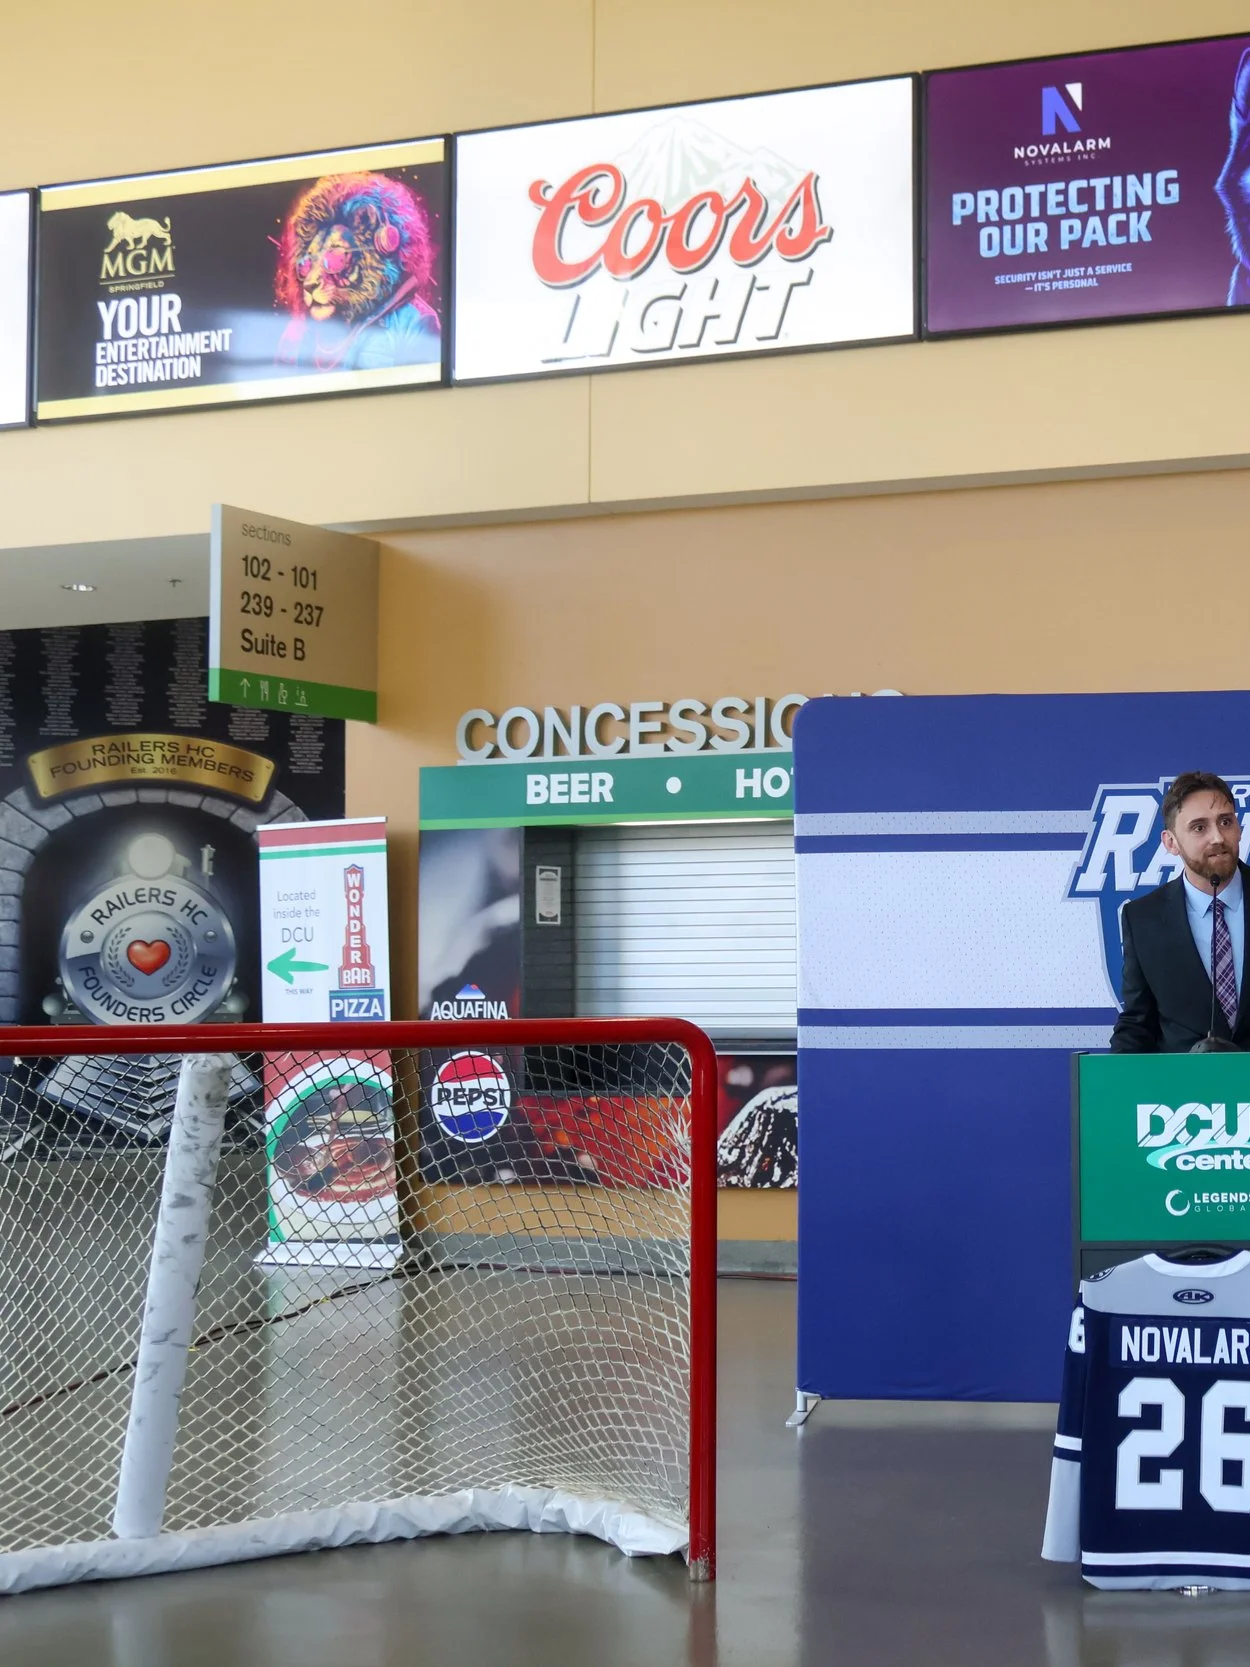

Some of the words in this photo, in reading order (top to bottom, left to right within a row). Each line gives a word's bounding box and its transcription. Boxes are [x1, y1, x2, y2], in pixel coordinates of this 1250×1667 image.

[1014, 136, 1112, 159] NOVALARM
[1024, 155, 1072, 167] SYSTEMS
[952, 169, 1180, 226] PROTECTING
[528, 163, 834, 290] Coors
[979, 221, 1049, 258] OUR
[1060, 210, 1153, 250] PACK
[100, 246, 176, 279] MGM
[994, 271, 1037, 285] SECURITY
[1037, 269, 1062, 281] ISN'T
[1062, 267, 1085, 278] JUST
[1086, 266, 1095, 276] A
[1095, 262, 1133, 276] SERVICE
[109, 280, 165, 294] SPRINGFIELD
[1052, 277, 1099, 291] PERSONAL
[97, 293, 183, 340] YOUR
[540, 267, 814, 363] LIGHT
[96, 328, 233, 365] ENTERTAINMENT
[95, 355, 202, 388] DESTINATION
[241, 522, 292, 547] sections
[241, 554, 272, 582] 102
[291, 565, 318, 592] 101
[240, 591, 274, 618] 239
[294, 601, 324, 628] 237
[240, 628, 287, 660] Suite
[293, 637, 306, 662] B
[455, 689, 905, 761] CONCESSIO
[91, 740, 180, 757] RAILERS
[186, 743, 215, 759] HC
[50, 753, 155, 779] FOUNDING
[168, 753, 254, 783] MEMBERS
[151, 766, 178, 776] 2016
[526, 771, 615, 805] BEER
[735, 766, 794, 799] HO
[90, 887, 177, 926] RAILERS
[179, 898, 208, 926] HC
[277, 889, 317, 902] Located
[273, 908, 302, 919] inside
[305, 906, 321, 918] the
[347, 872, 363, 964] WONDER
[281, 926, 315, 943] DCU
[285, 987, 299, 995] THIS
[300, 987, 314, 995] WAY
[343, 967, 371, 985] BAR
[78, 965, 166, 1024] FOUNDERS
[171, 963, 218, 1017] CIRCLE
[331, 997, 383, 1018] PIZZA
[430, 1000, 509, 1021] AQUAFINA
[437, 1087, 505, 1107] PEPSI
